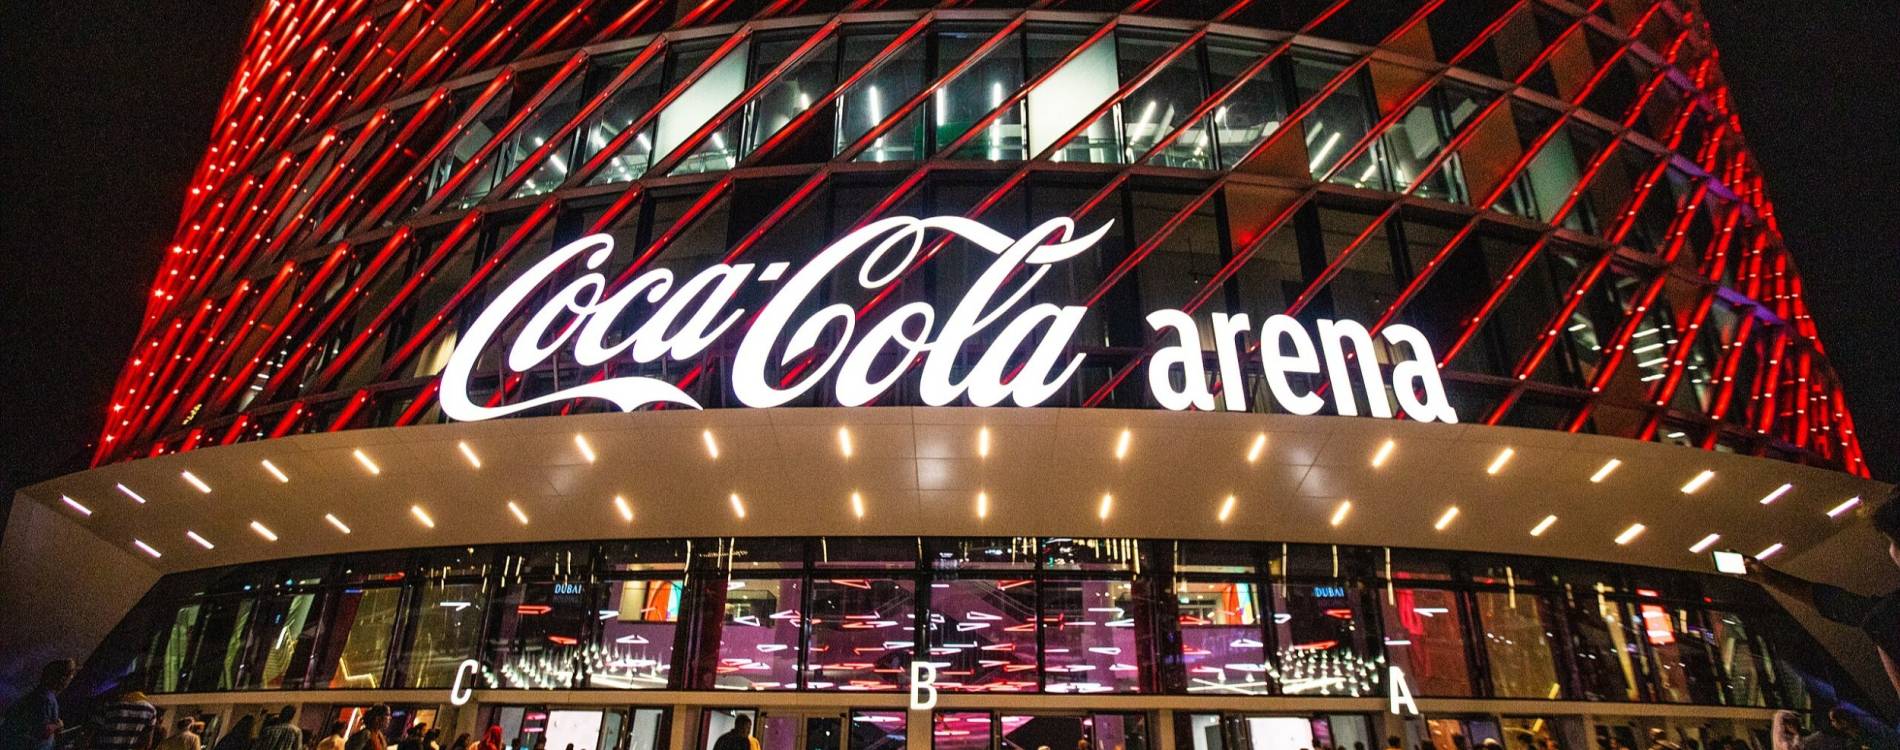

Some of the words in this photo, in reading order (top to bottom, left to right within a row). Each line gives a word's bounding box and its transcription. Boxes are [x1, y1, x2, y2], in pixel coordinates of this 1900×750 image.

[439, 215, 1115, 421] Coca-Cola
[1145, 308, 1459, 424] arena
[554, 583, 583, 595] DUBAI
[1314, 586, 1345, 598] DUBAI
[450, 659, 479, 705] C
[910, 661, 938, 710] B
[1388, 666, 1419, 715] A
